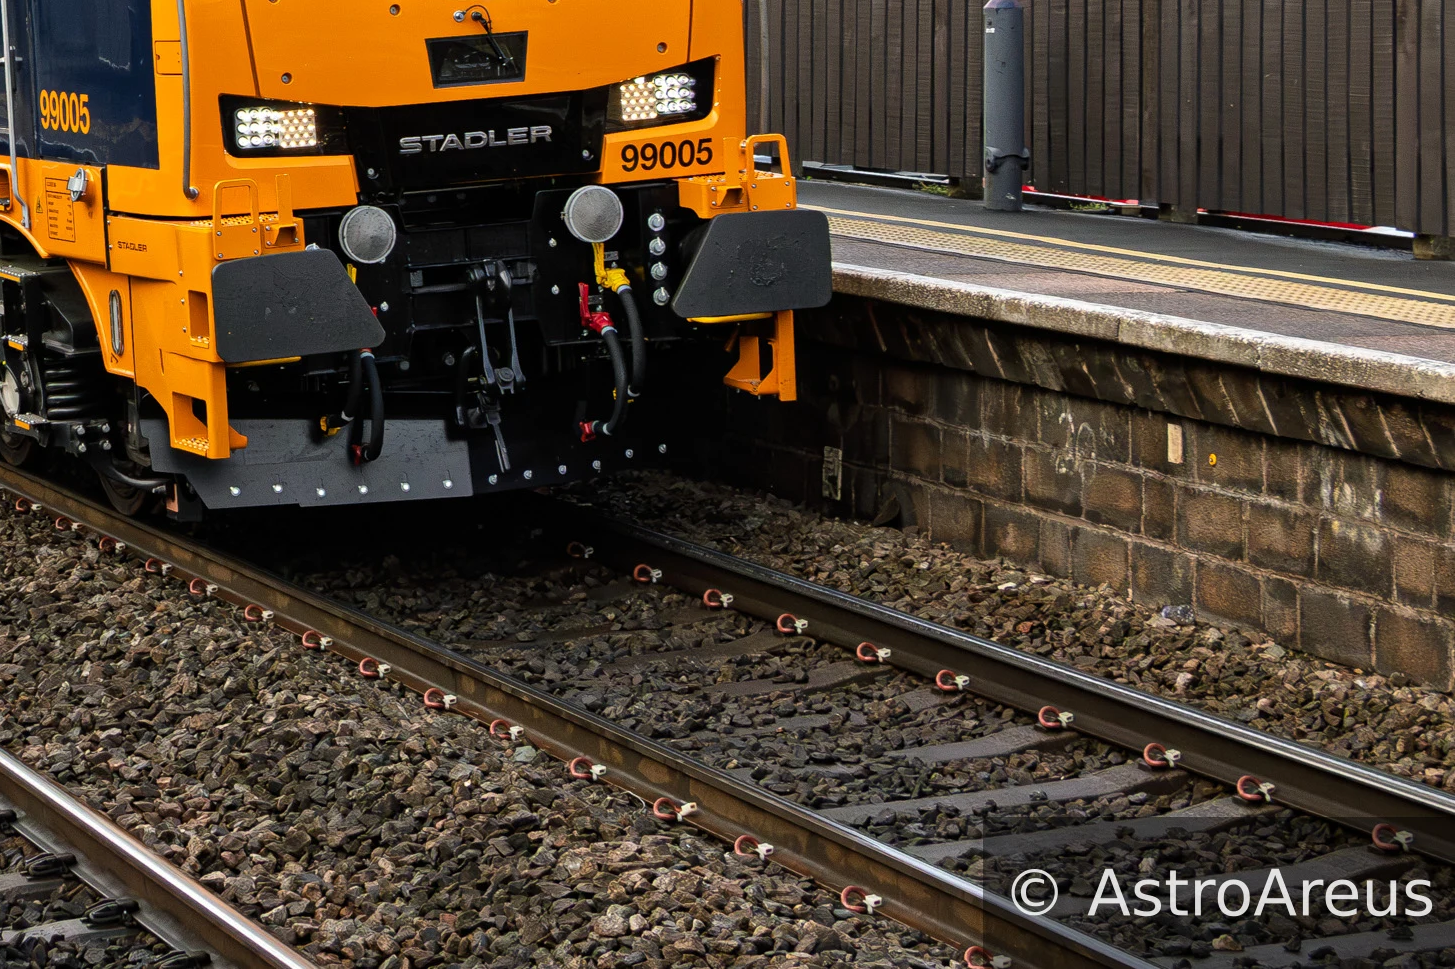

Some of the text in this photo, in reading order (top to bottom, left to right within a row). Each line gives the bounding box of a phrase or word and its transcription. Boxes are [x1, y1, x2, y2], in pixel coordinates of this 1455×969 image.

[39, 89, 91, 135] 99005
[399, 125, 553, 155] STADLER
[620, 137, 714, 173] 99005
[117, 240, 148, 253] STADLER
